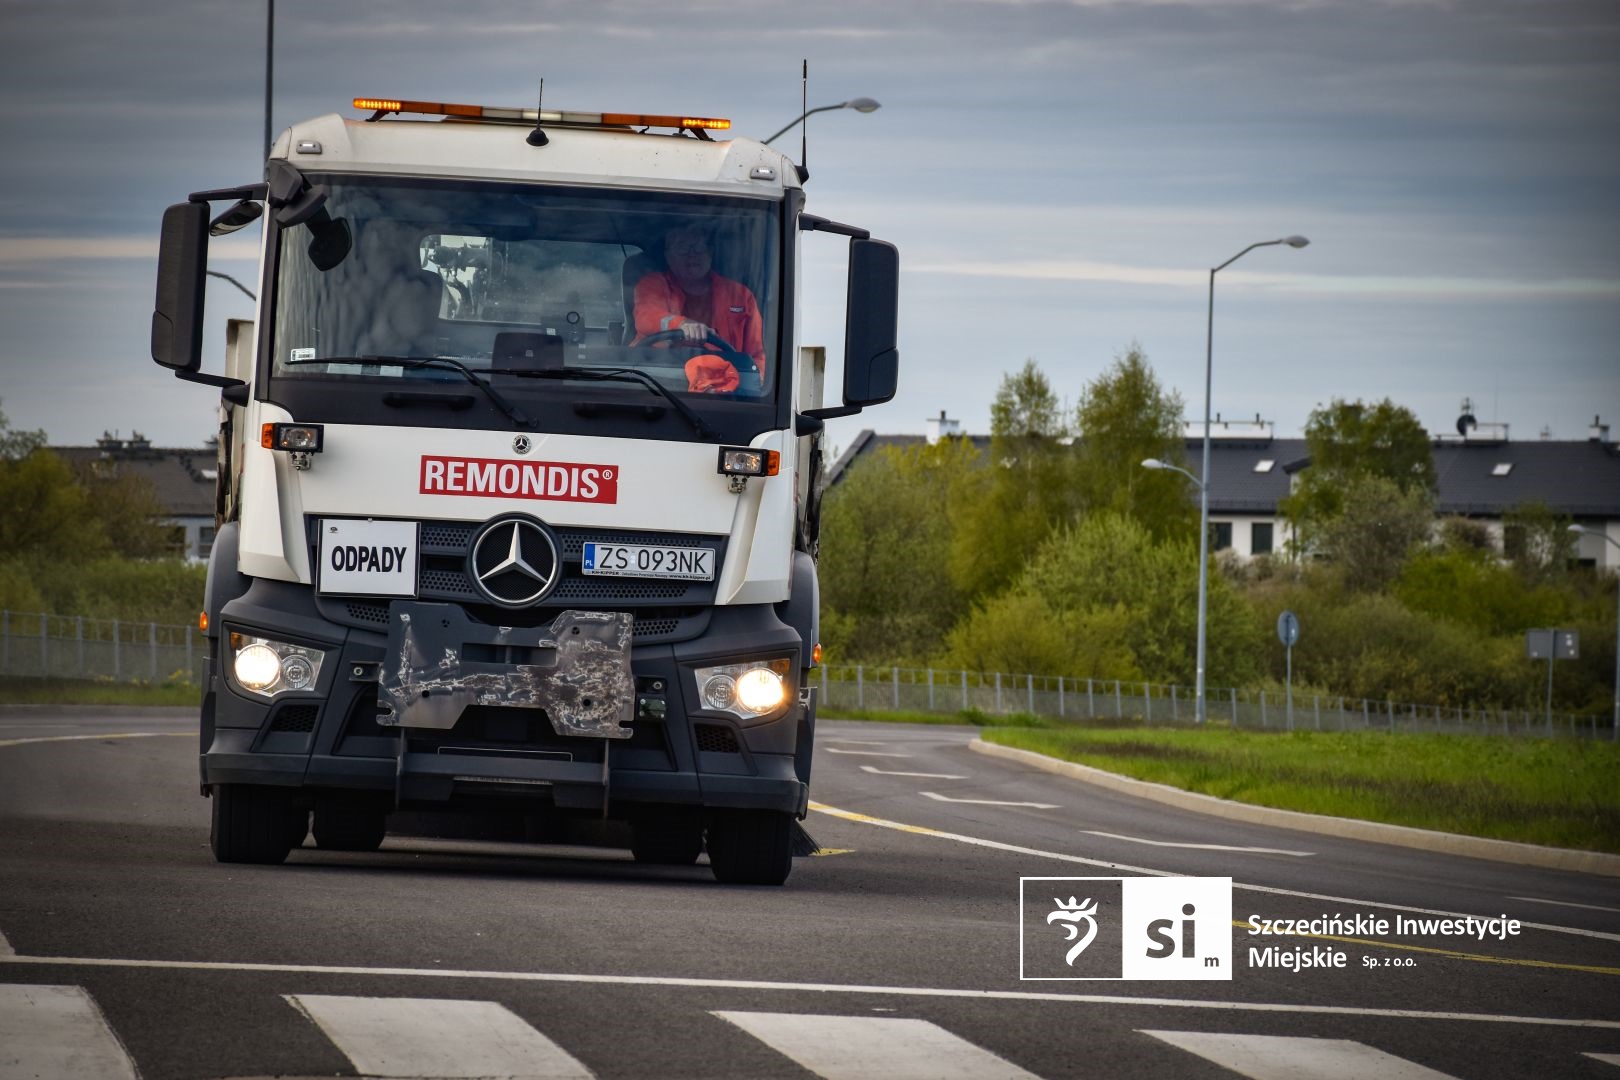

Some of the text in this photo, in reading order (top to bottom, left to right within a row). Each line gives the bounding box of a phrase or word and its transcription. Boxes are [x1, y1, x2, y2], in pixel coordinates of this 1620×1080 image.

[331, 545, 407, 573] ODPADY
[599, 547, 707, 573] ZS 093NK
